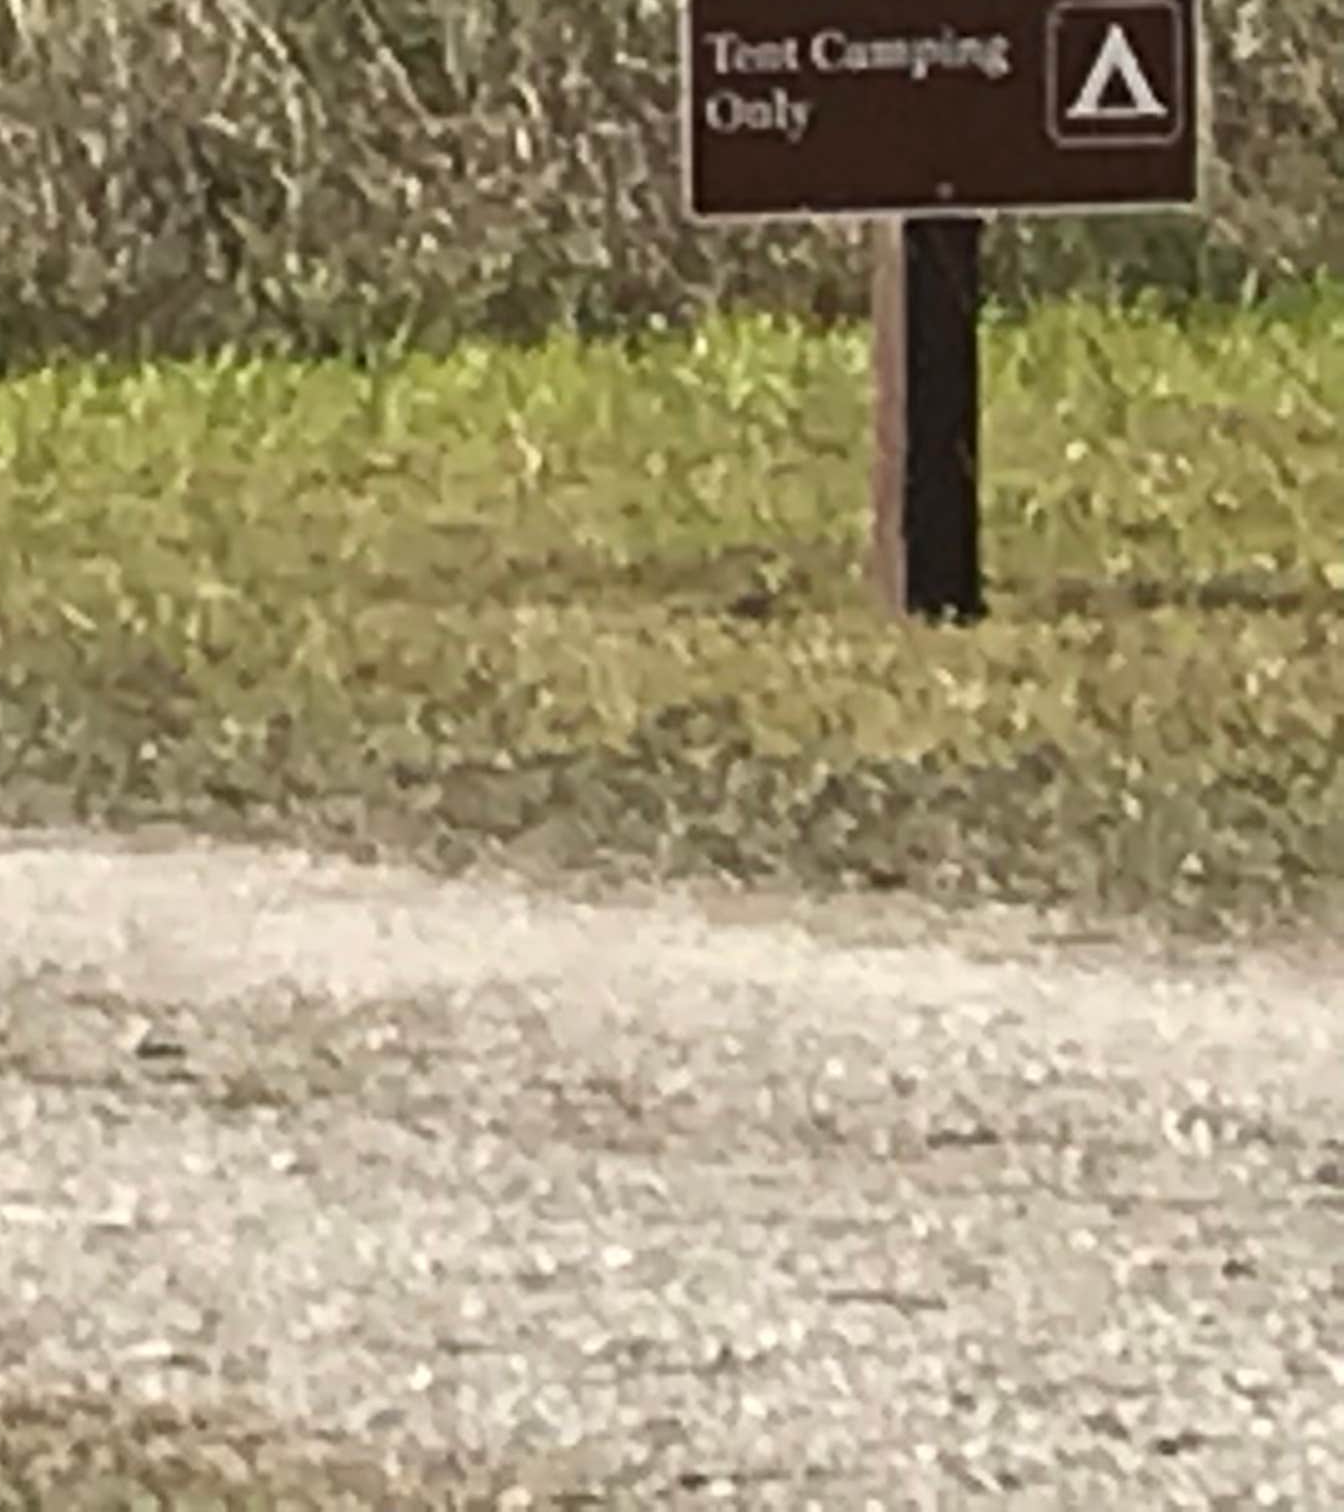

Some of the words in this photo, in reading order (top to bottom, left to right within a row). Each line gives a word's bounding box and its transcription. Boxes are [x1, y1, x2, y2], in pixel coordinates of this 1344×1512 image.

[705, 31, 800, 74] Tent
[810, 26, 1011, 79] Camping
[705, 88, 810, 142] Only
